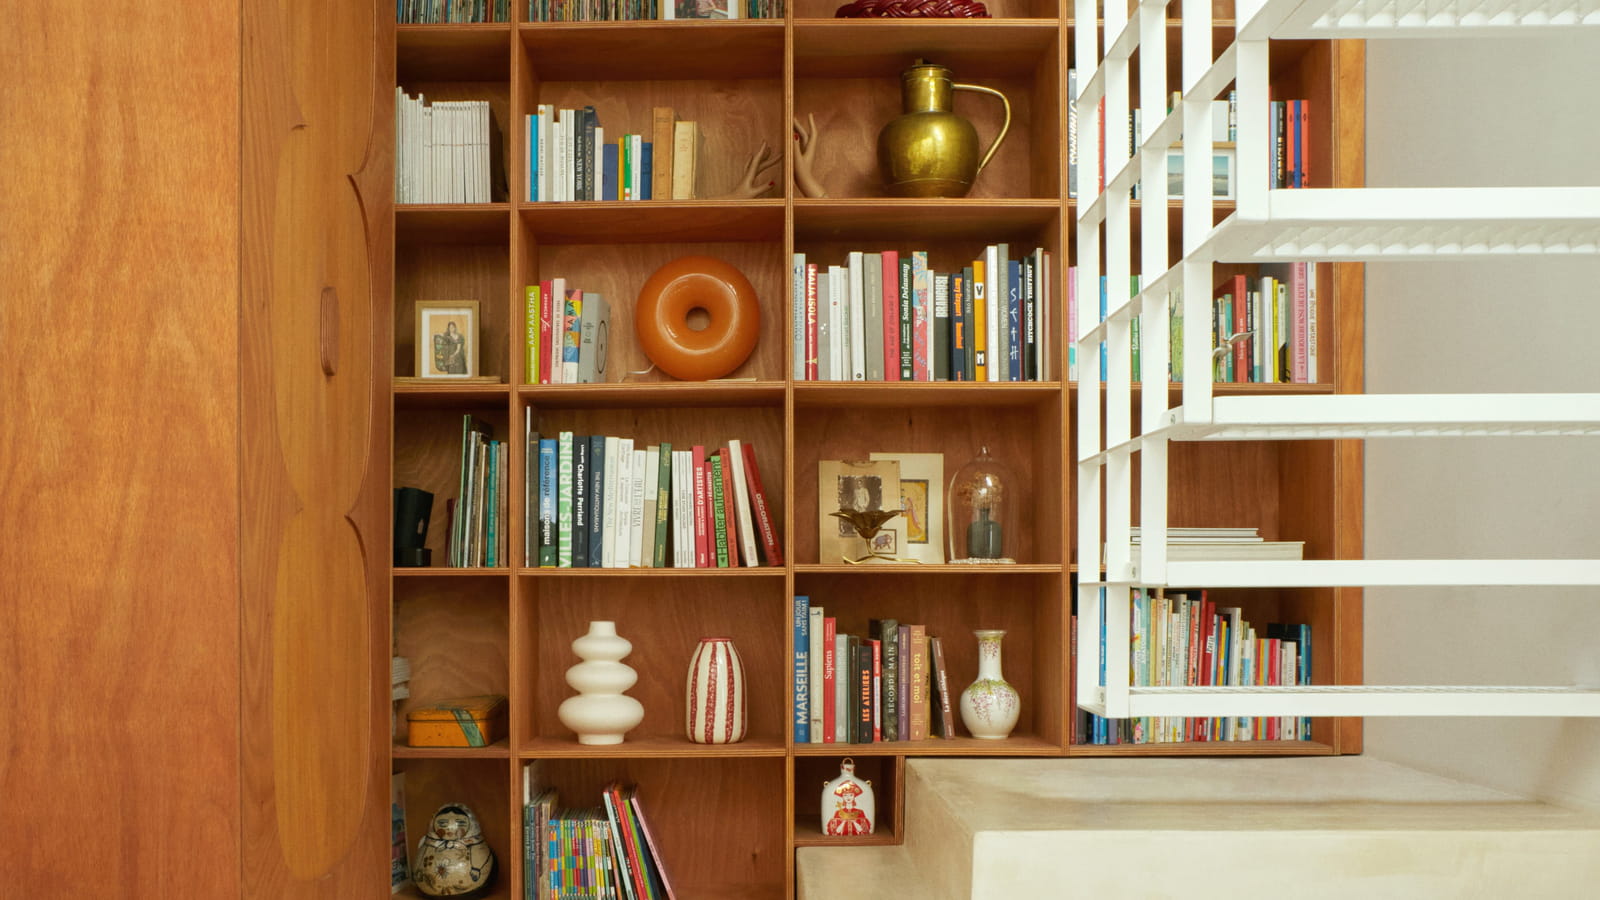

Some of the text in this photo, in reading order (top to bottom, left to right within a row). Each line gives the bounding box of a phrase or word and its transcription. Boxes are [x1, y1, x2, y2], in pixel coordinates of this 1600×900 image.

[808, 268, 816, 325] MAIJA ISOLA
[903, 264, 911, 300] Delaunay
[936, 276, 948, 318] BRANCUSI
[528, 326, 536, 345] AAM
[544, 497, 550, 508] de
[560, 432, 572, 568] VILLES-JARDINS
[713, 460, 727, 556] Habiter autrement
[825, 650, 834, 680] Sapiens
[914, 672, 921, 684] et
[797, 651, 808, 724] MARSEILLE
[945, 704, 950, 712] La
